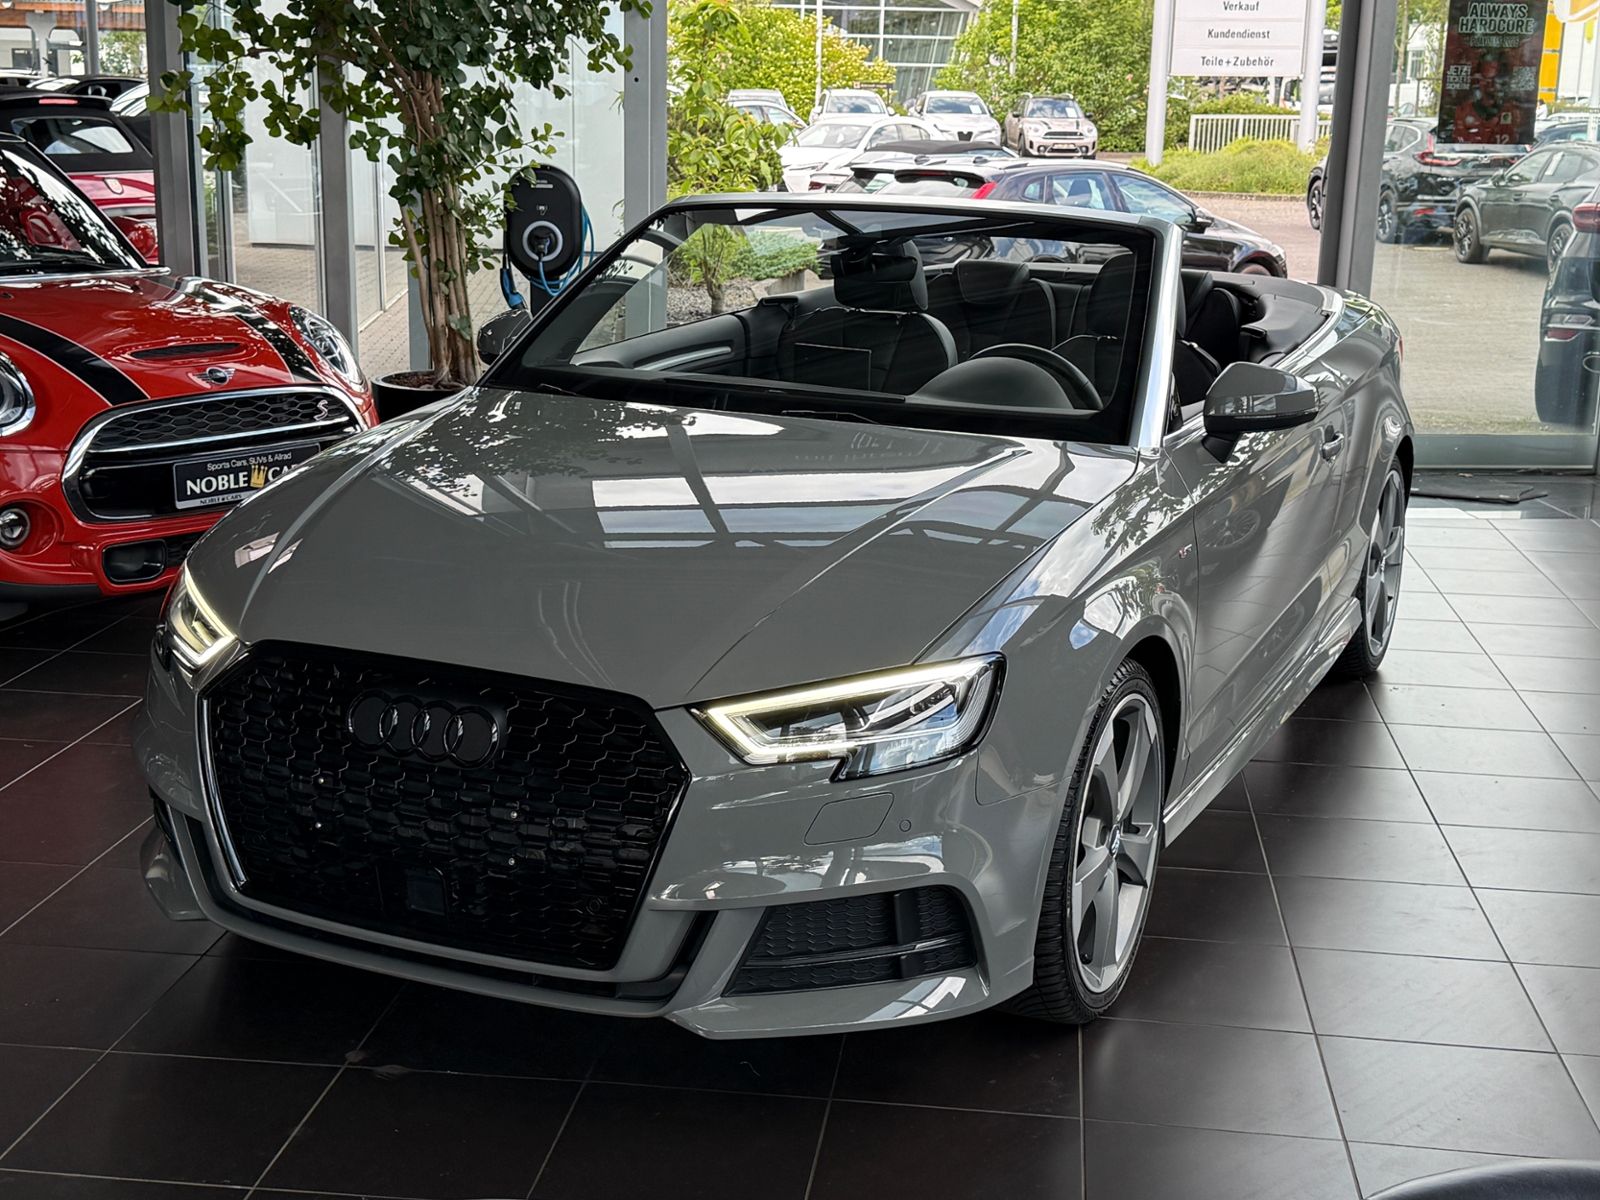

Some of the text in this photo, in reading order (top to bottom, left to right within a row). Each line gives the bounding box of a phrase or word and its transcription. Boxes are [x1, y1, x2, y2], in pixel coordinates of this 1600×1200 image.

[1223, 1, 1260, 11] Verkauf
[1469, 2, 1528, 18] ALWAYS
[1458, 17, 1535, 34] HARDCORE
[1207, 29, 1271, 39] Kundendienst
[206, 461, 230, 472] Sports
[248, 456, 267, 466] SUVs
[267, 454, 273, 463] &
[274, 452, 292, 462] Allrad
[186, 471, 249, 496] NOBLE
